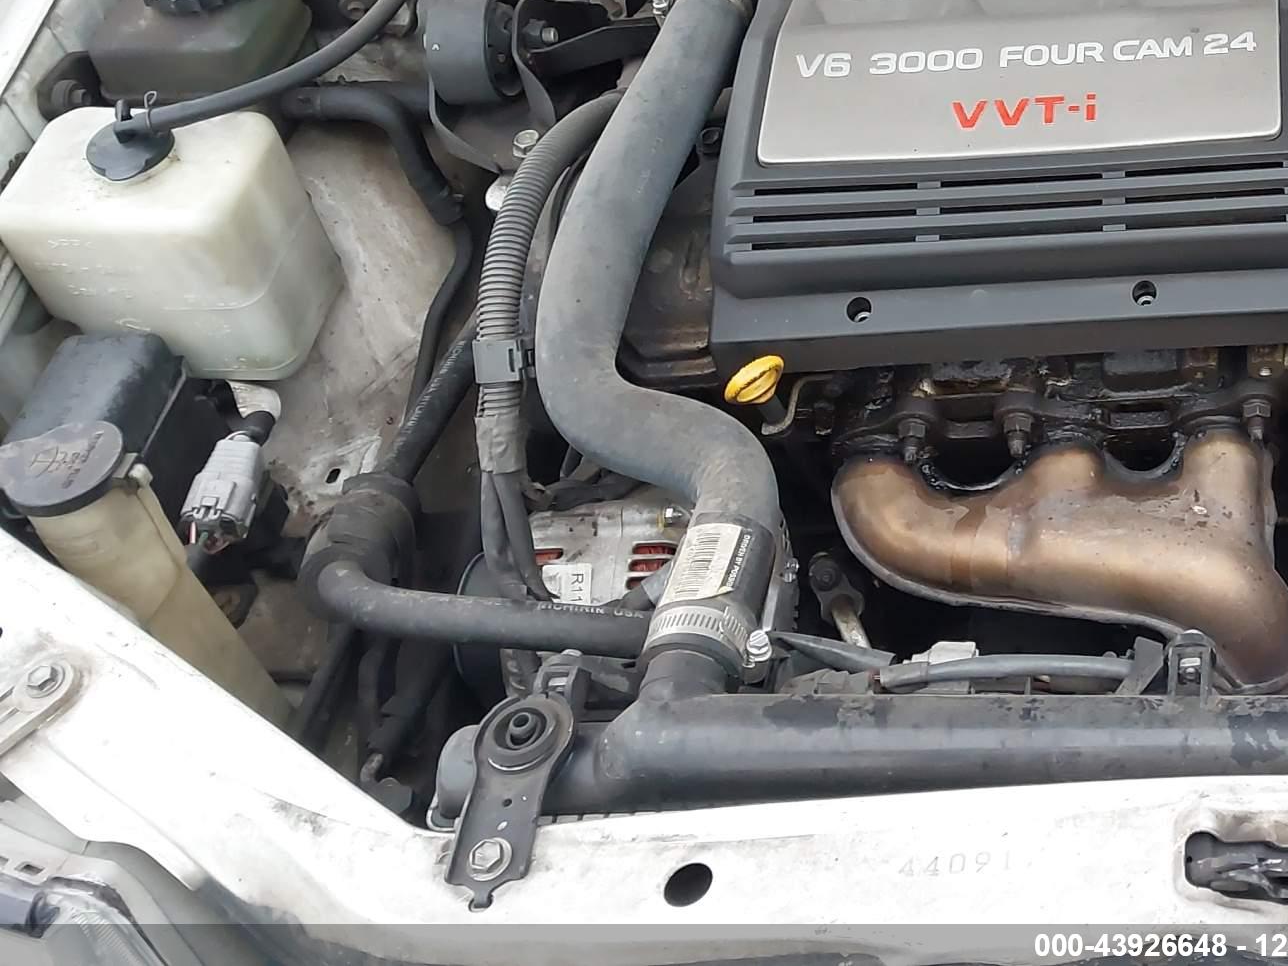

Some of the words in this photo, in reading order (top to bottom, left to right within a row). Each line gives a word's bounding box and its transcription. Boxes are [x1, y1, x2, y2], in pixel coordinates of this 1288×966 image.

[796, 52, 852, 78] V6
[869, 48, 983, 75] 3000
[999, 40, 1104, 68] FOUR
[1112, 35, 1193, 60] CAM
[1203, 31, 1257, 56] 24
[952, 92, 1097, 129] VVT-i
